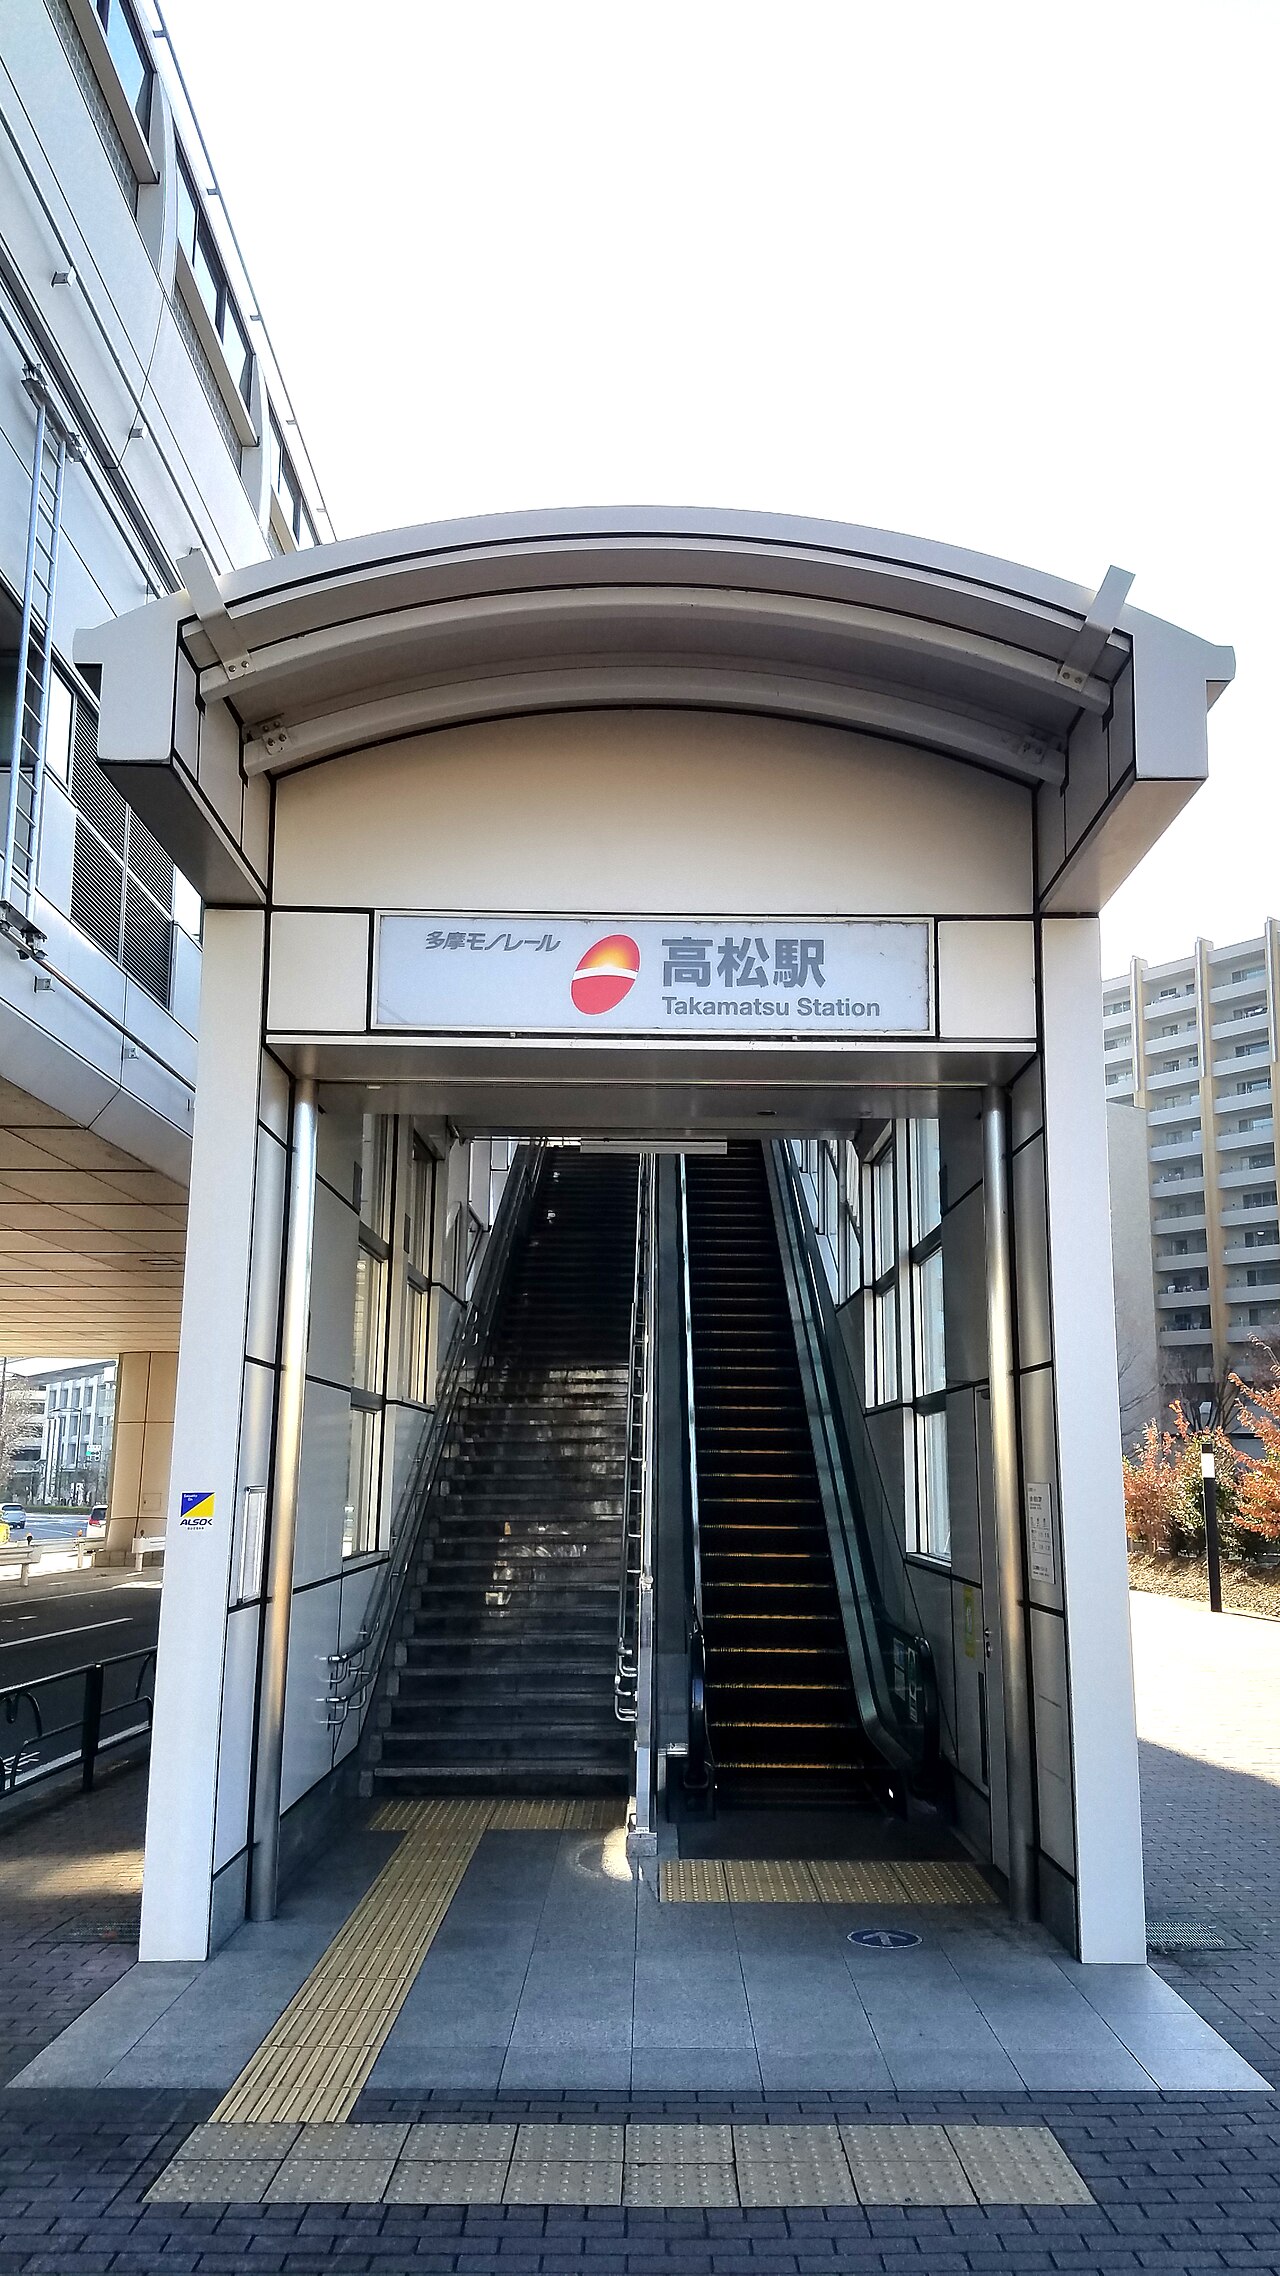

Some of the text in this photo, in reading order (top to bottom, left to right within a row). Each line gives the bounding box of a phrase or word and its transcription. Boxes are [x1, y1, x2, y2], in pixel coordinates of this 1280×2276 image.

[425, 931, 561, 951] 多摩モノレール
[661, 936, 826, 988] 高松駅
[661, 996, 880, 1017] Takamatsu Station
